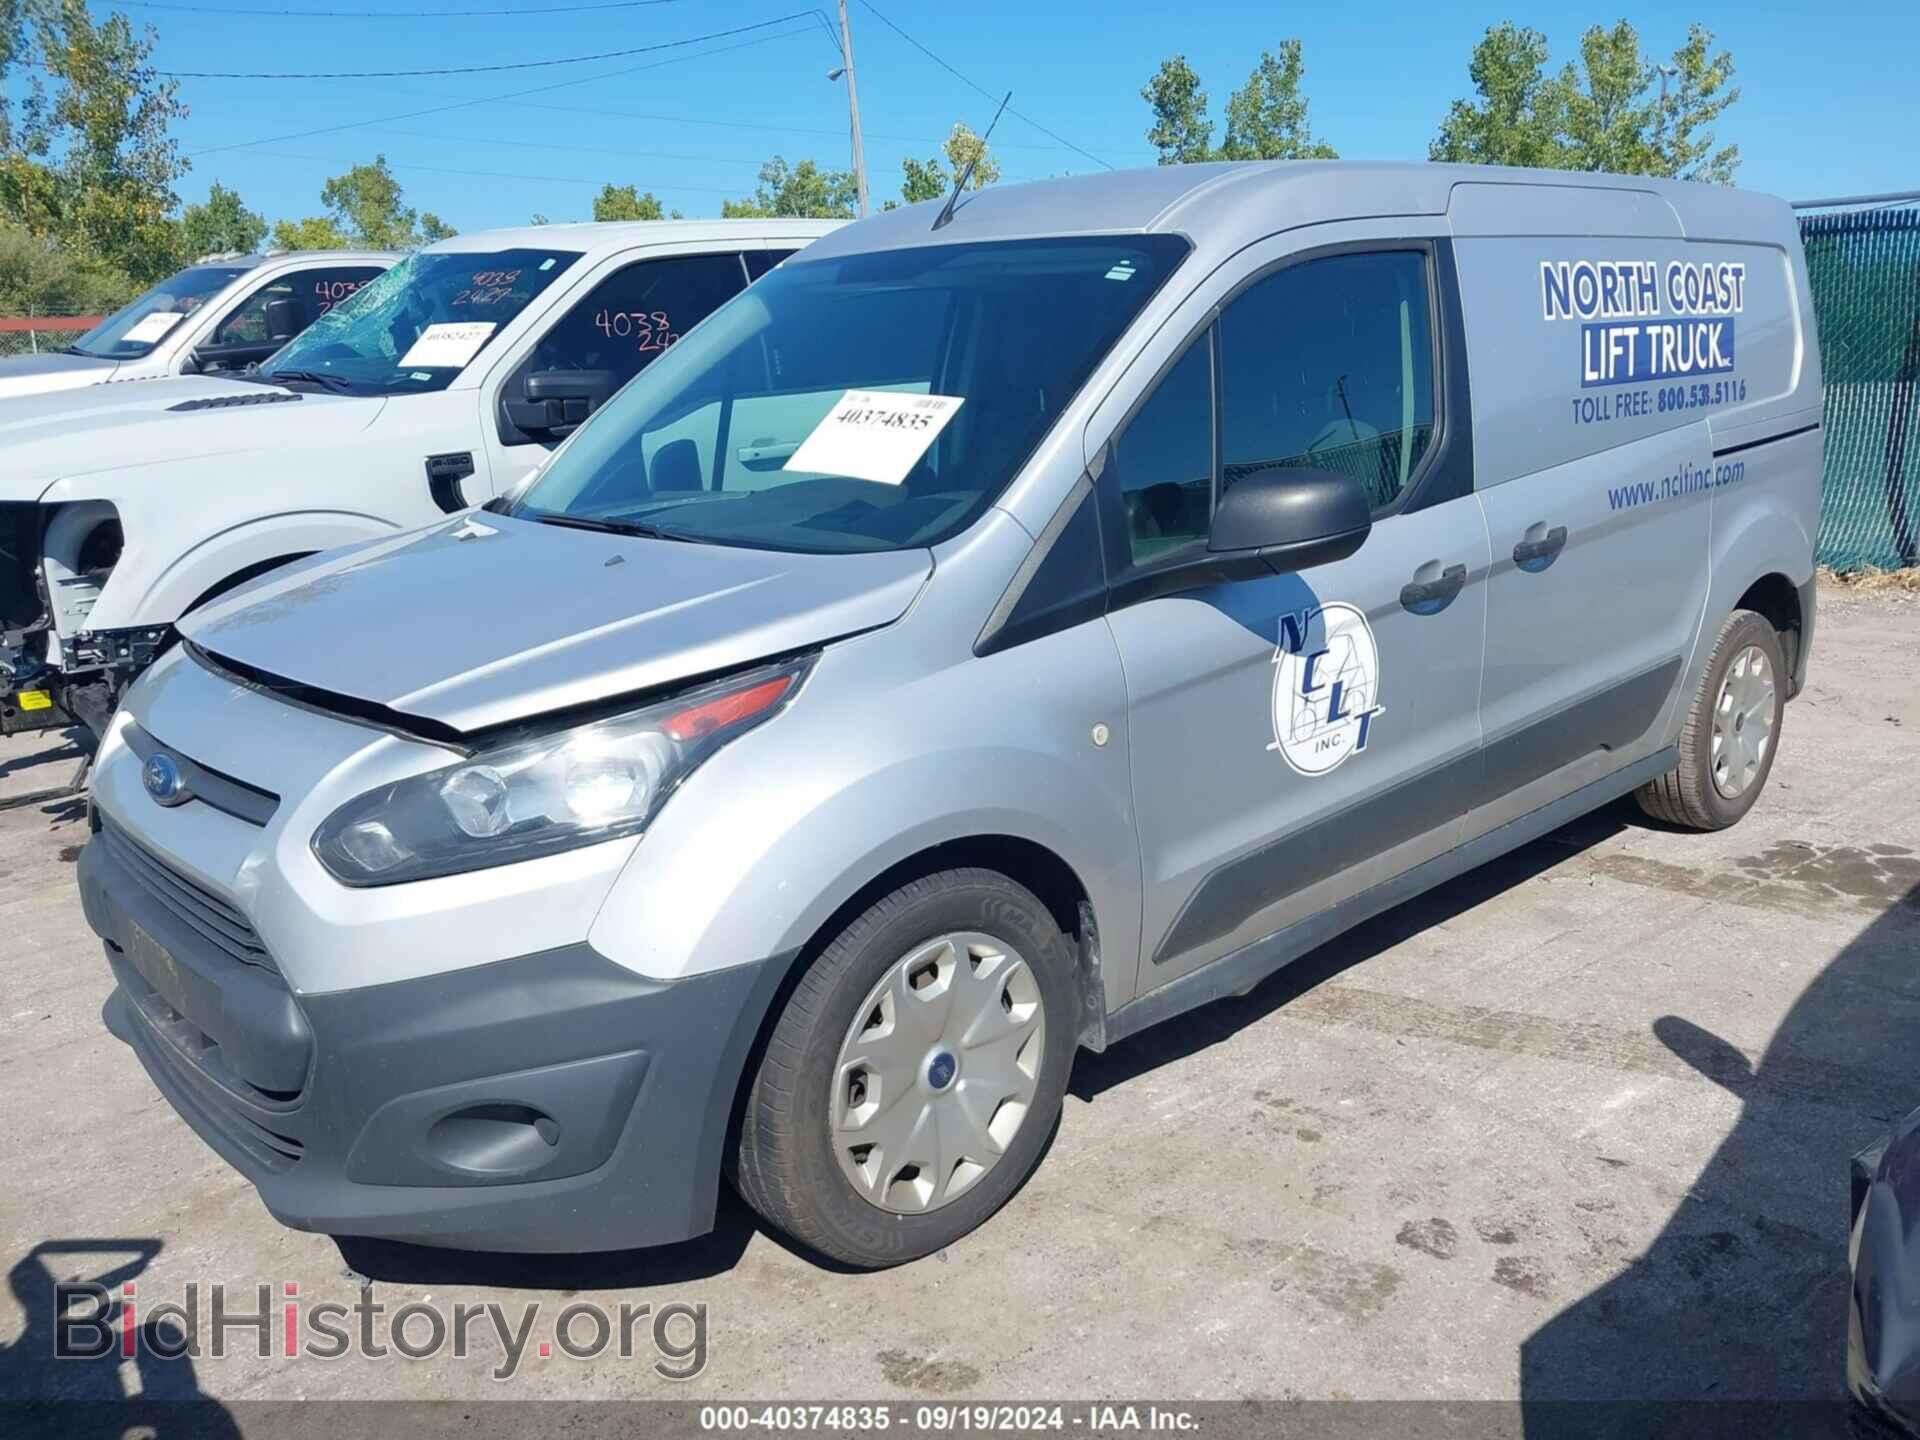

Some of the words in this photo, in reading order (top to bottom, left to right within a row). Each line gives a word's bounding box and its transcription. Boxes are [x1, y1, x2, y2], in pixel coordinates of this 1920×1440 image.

[1540, 260, 1660, 320] NORTH
[1665, 260, 1745, 315] COAST
[595, 309, 670, 337] 4038
[1584, 325, 1640, 382] LIFT
[1646, 322, 1724, 375] TRUCK
[837, 408, 933, 431] 40374835
[1572, 396, 1611, 425] TOLL
[1615, 389, 1653, 419] FREE:
